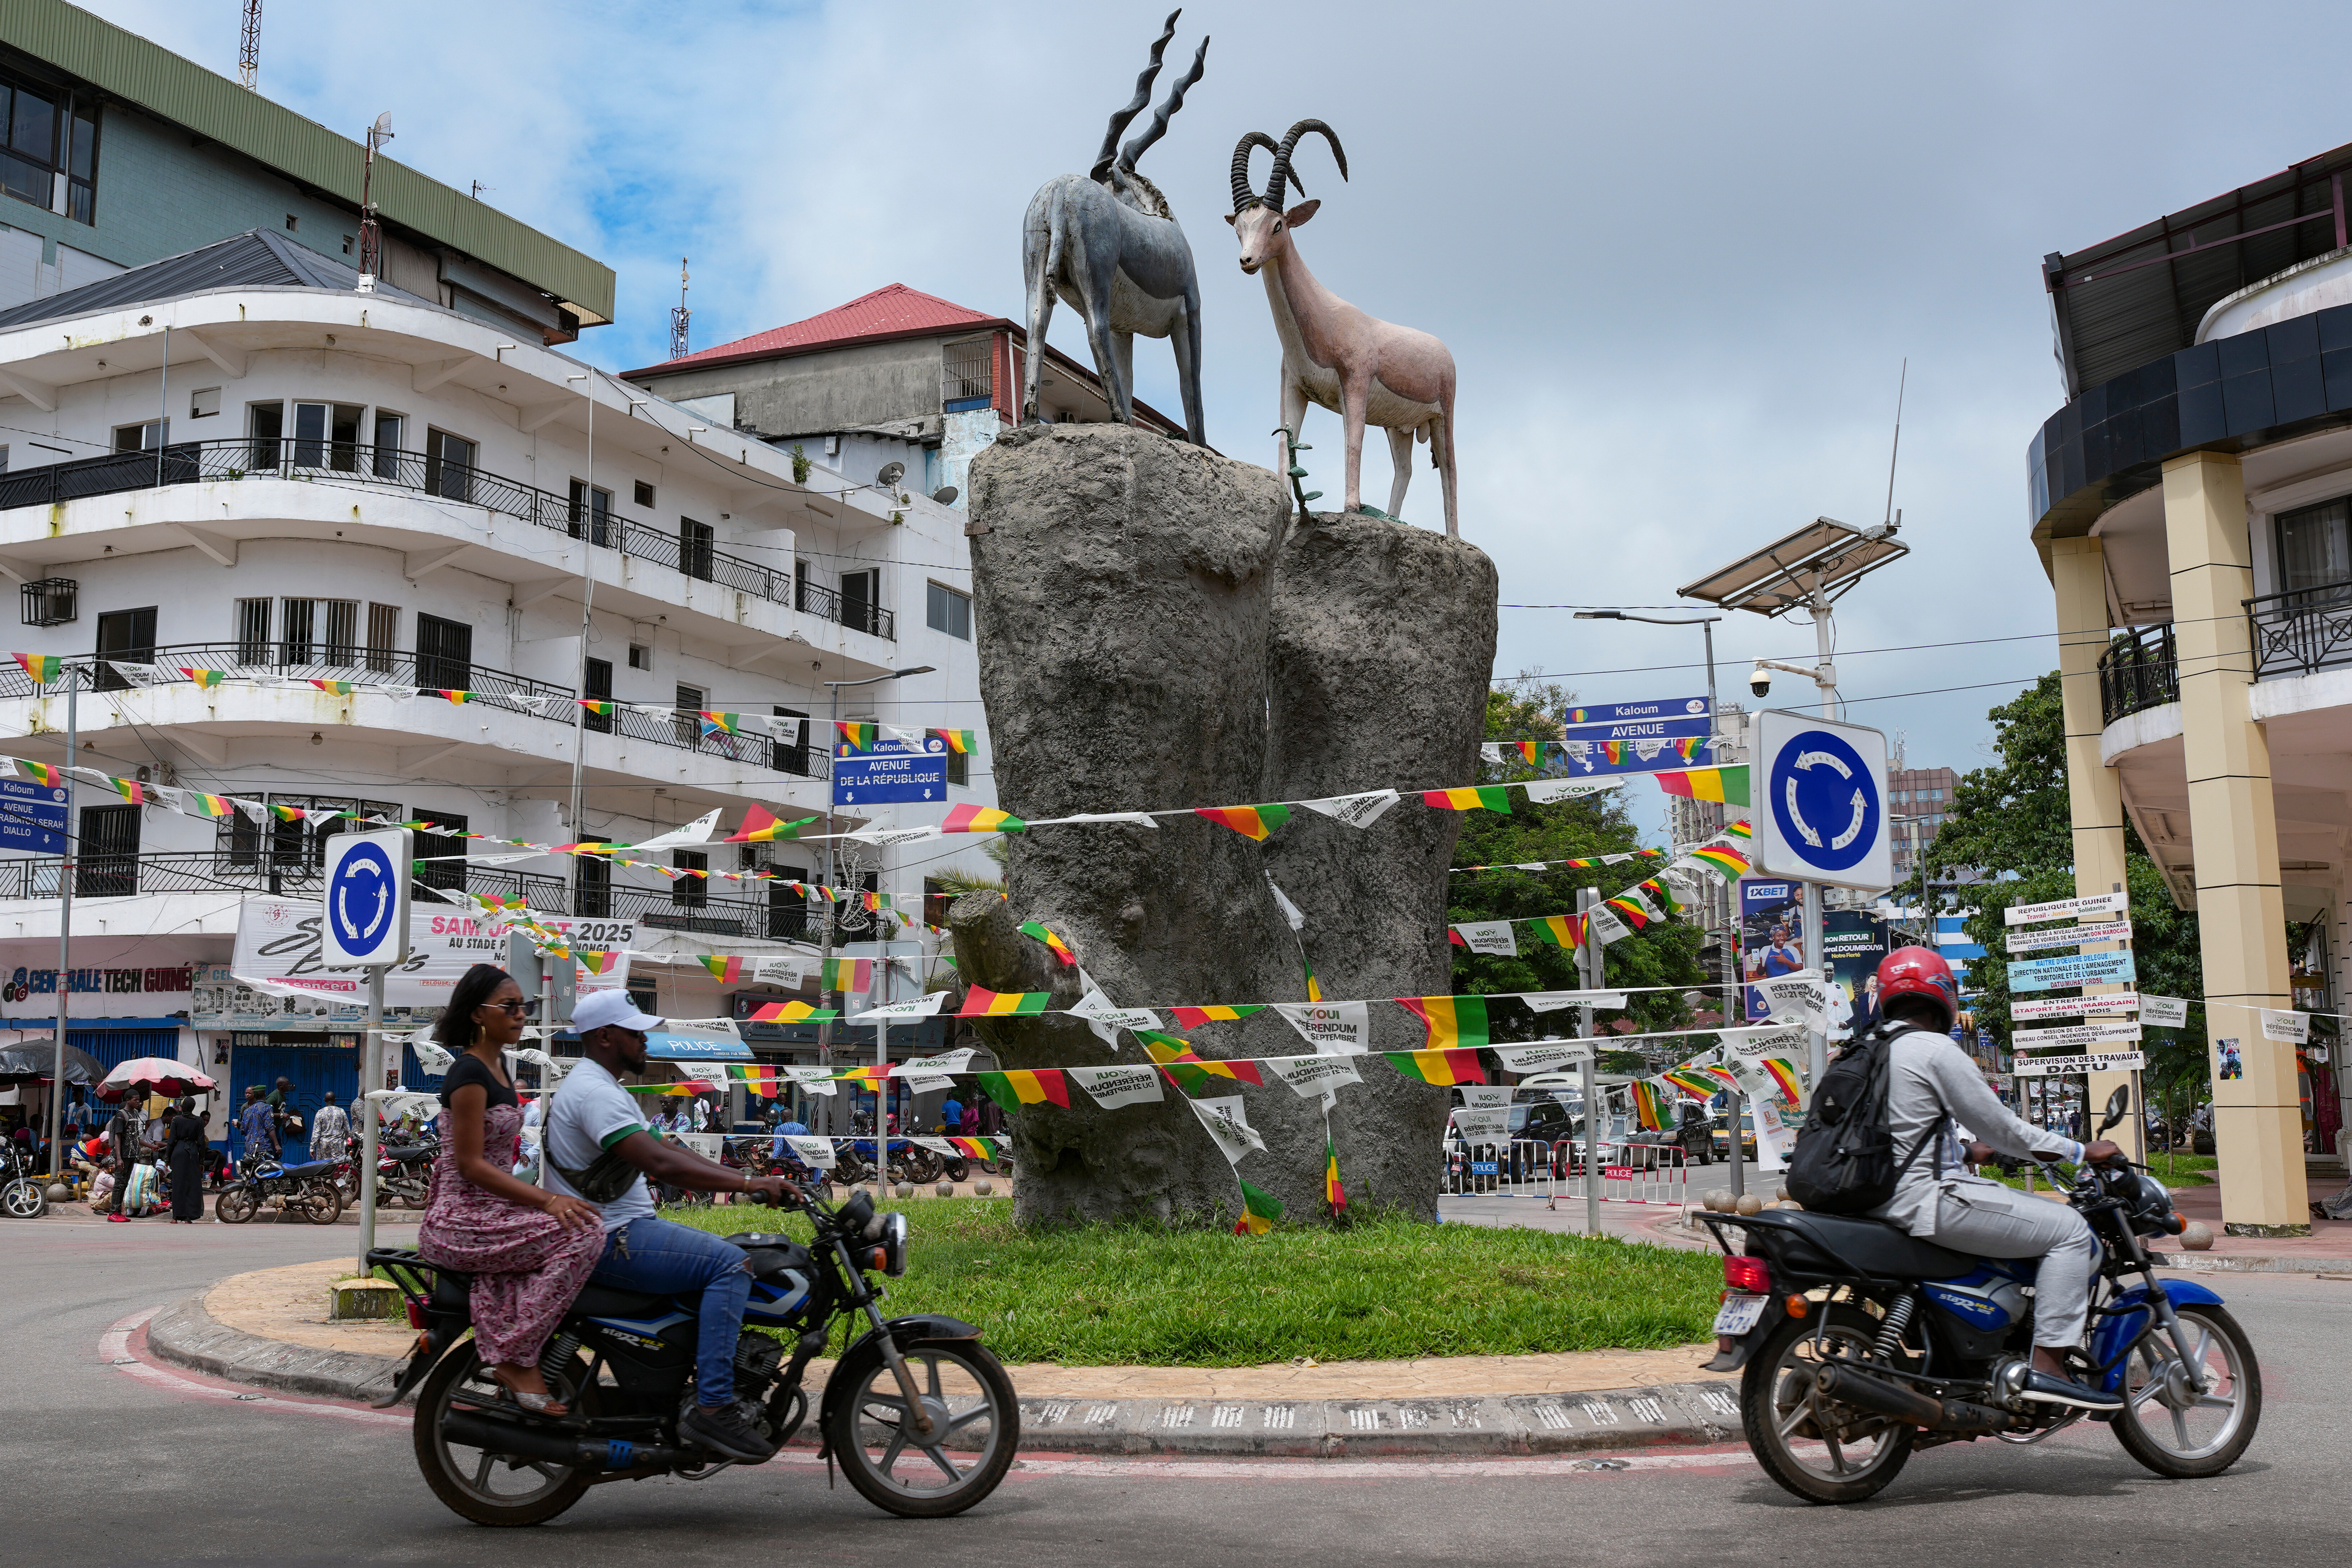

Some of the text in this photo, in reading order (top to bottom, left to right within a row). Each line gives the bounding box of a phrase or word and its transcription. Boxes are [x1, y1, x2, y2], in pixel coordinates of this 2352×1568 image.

[1616, 705, 1658, 716] Kaloum
[1612, 723, 1664, 737] AVENUE
[873, 743, 907, 752] Kaloum
[869, 760, 910, 771] AVENUE
[841, 772, 939, 786] DE LA RÉPUBLIQUE
[4, 782, 34, 795] Kaloum
[4, 802, 33, 814] AVENUE
[1351, 795, 1390, 822] SEPTEMBRE
[39, 819, 63, 829] SERAH
[4, 826, 31, 836] DIALLO
[1750, 887, 1786, 897] 1XBET
[2018, 903, 2067, 914] REPUBLIQUE
[2082, 897, 2112, 905] GUINEE
[2078, 904, 2106, 913] Solidarité
[578, 922, 633, 942] 2025
[449, 937, 496, 950] AU STADE
[2028, 936, 2111, 950] COOPERATION GUINEO-MAROCAINE
[29, 969, 102, 993] CENRALE
[104, 969, 142, 993] TECH
[2034, 974, 2064, 982] TERRITOIRE
[293, 981, 353, 990] concert
[2051, 979, 2084, 988] DATU/MUHAT
[2044, 996, 2097, 1005] ENTREPRISE
[2081, 999, 2135, 1009] (MAROCAIN)
[1316, 1010, 1340, 1019] OUI
[694, 1024, 731, 1032] SEPTEMBRE
[2266, 1024, 2304, 1033] RÉFÉRENDUM
[1311, 1033, 1357, 1042] SEPTEMBRE
[667, 1041, 721, 1051] POLICE
[2018, 1057, 2075, 1066] SUPERVISION
[2047, 1063, 2107, 1074] DATU
[1212, 1116, 1226, 1128] OUI
[1464, 1124, 1503, 1132] RÉFÉRENDUM
[1605, 1169, 1632, 1178] POLICE
